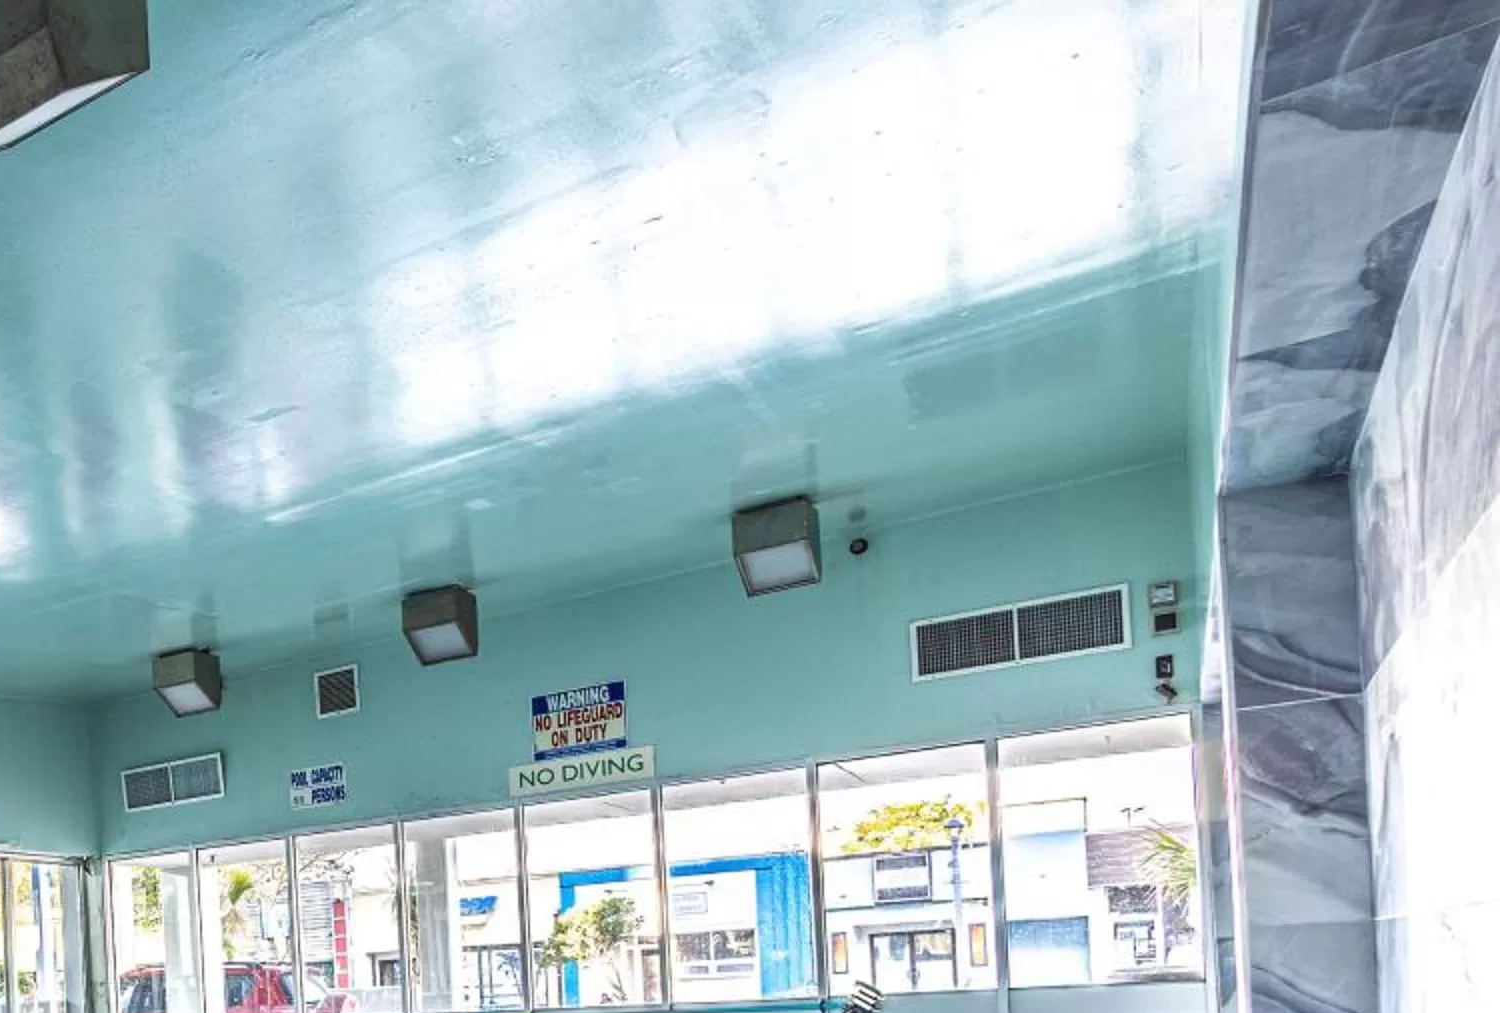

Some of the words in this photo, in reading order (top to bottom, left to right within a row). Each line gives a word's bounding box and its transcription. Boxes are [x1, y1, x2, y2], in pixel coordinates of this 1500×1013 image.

[546, 685, 610, 712] WARNING
[535, 714, 552, 732] NO
[557, 702, 623, 729] LIFEGUARD
[551, 730, 569, 747] ON
[575, 723, 607, 743] DUTY
[519, 767, 555, 789] NO
[561, 753, 644, 783] DIVING
[311, 784, 345, 805] PERSONS
